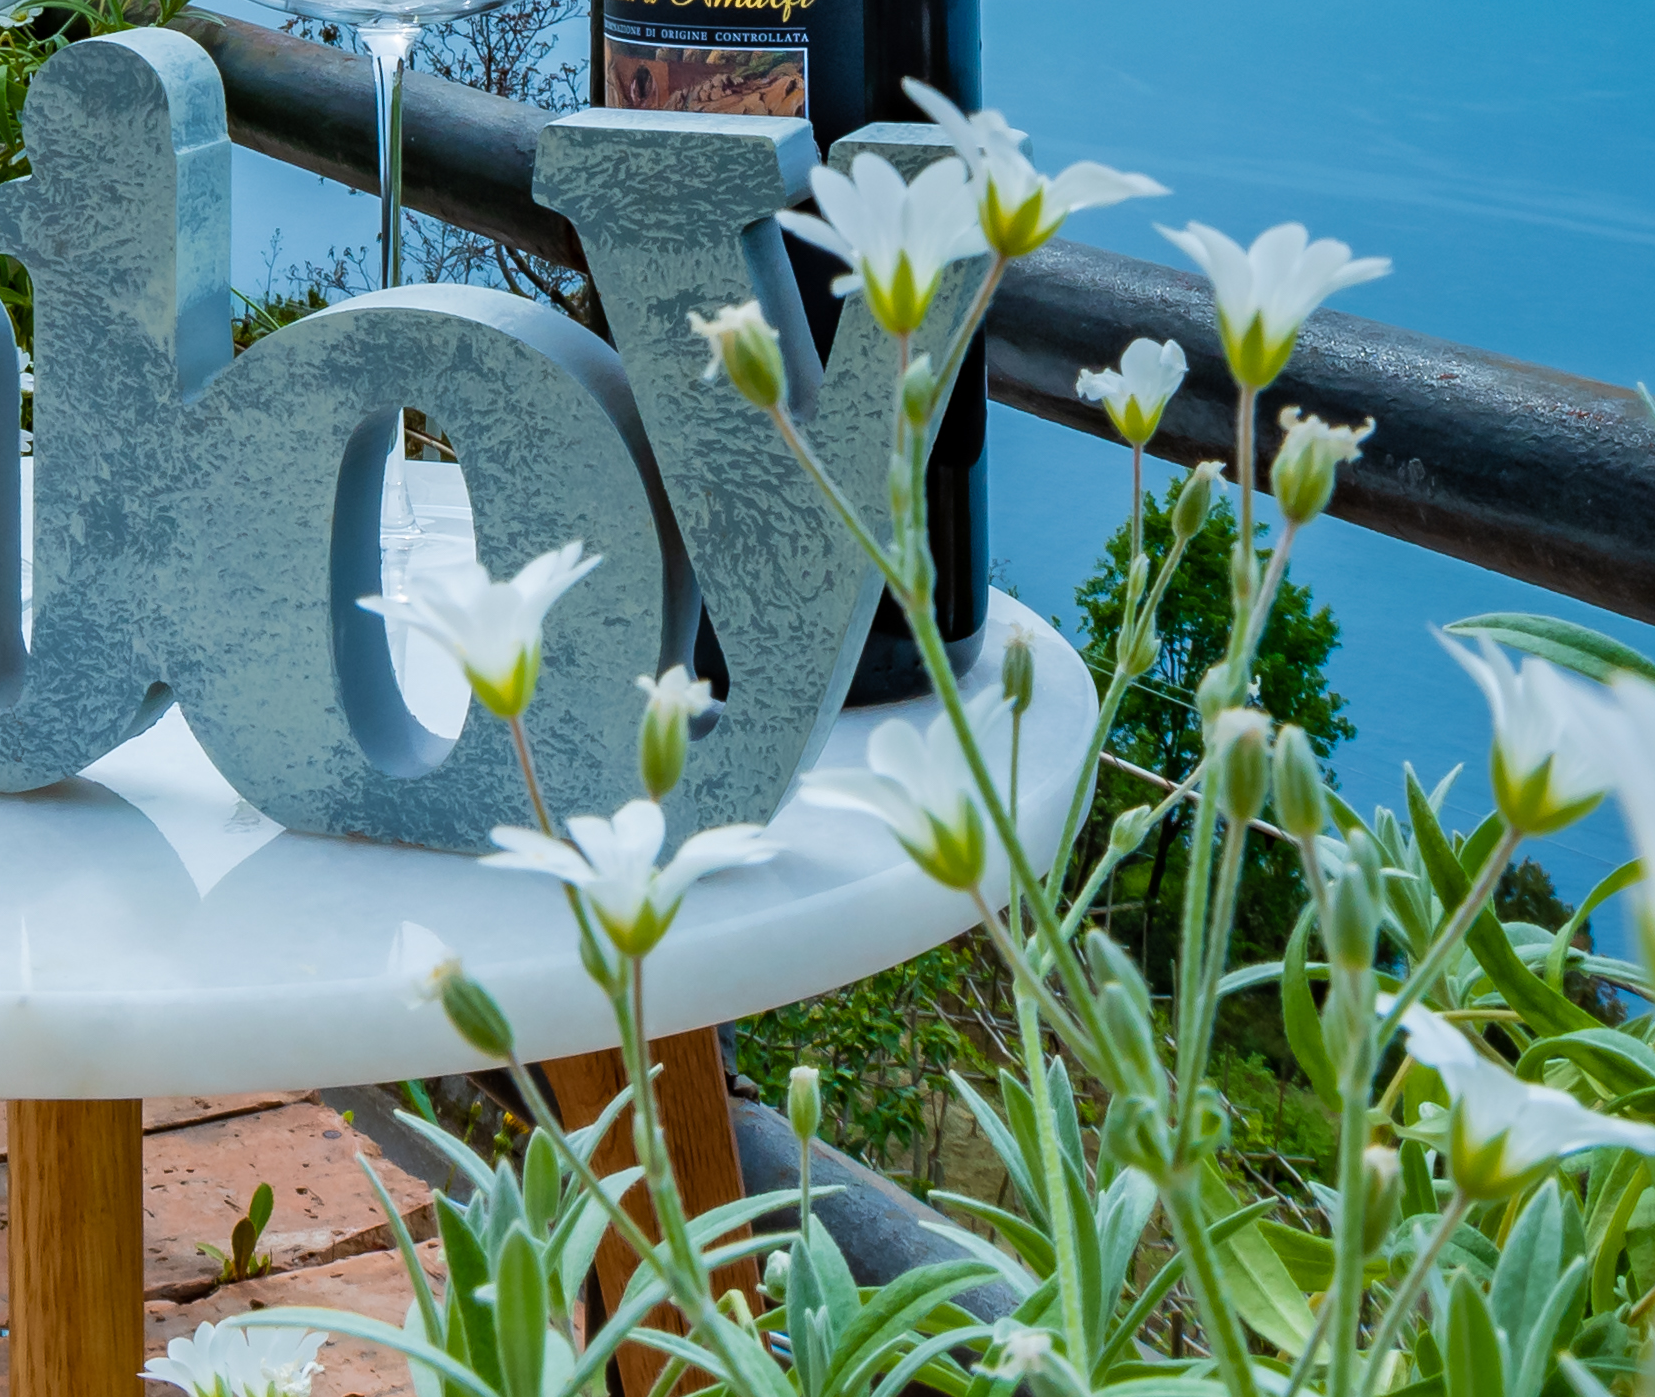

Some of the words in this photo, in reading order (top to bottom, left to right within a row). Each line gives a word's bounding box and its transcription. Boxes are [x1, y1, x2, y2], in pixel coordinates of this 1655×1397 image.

[646, 28, 656, 38] DI
[661, 29, 708, 42] ORIGINE
[715, 32, 809, 43] CONTROLLATA
